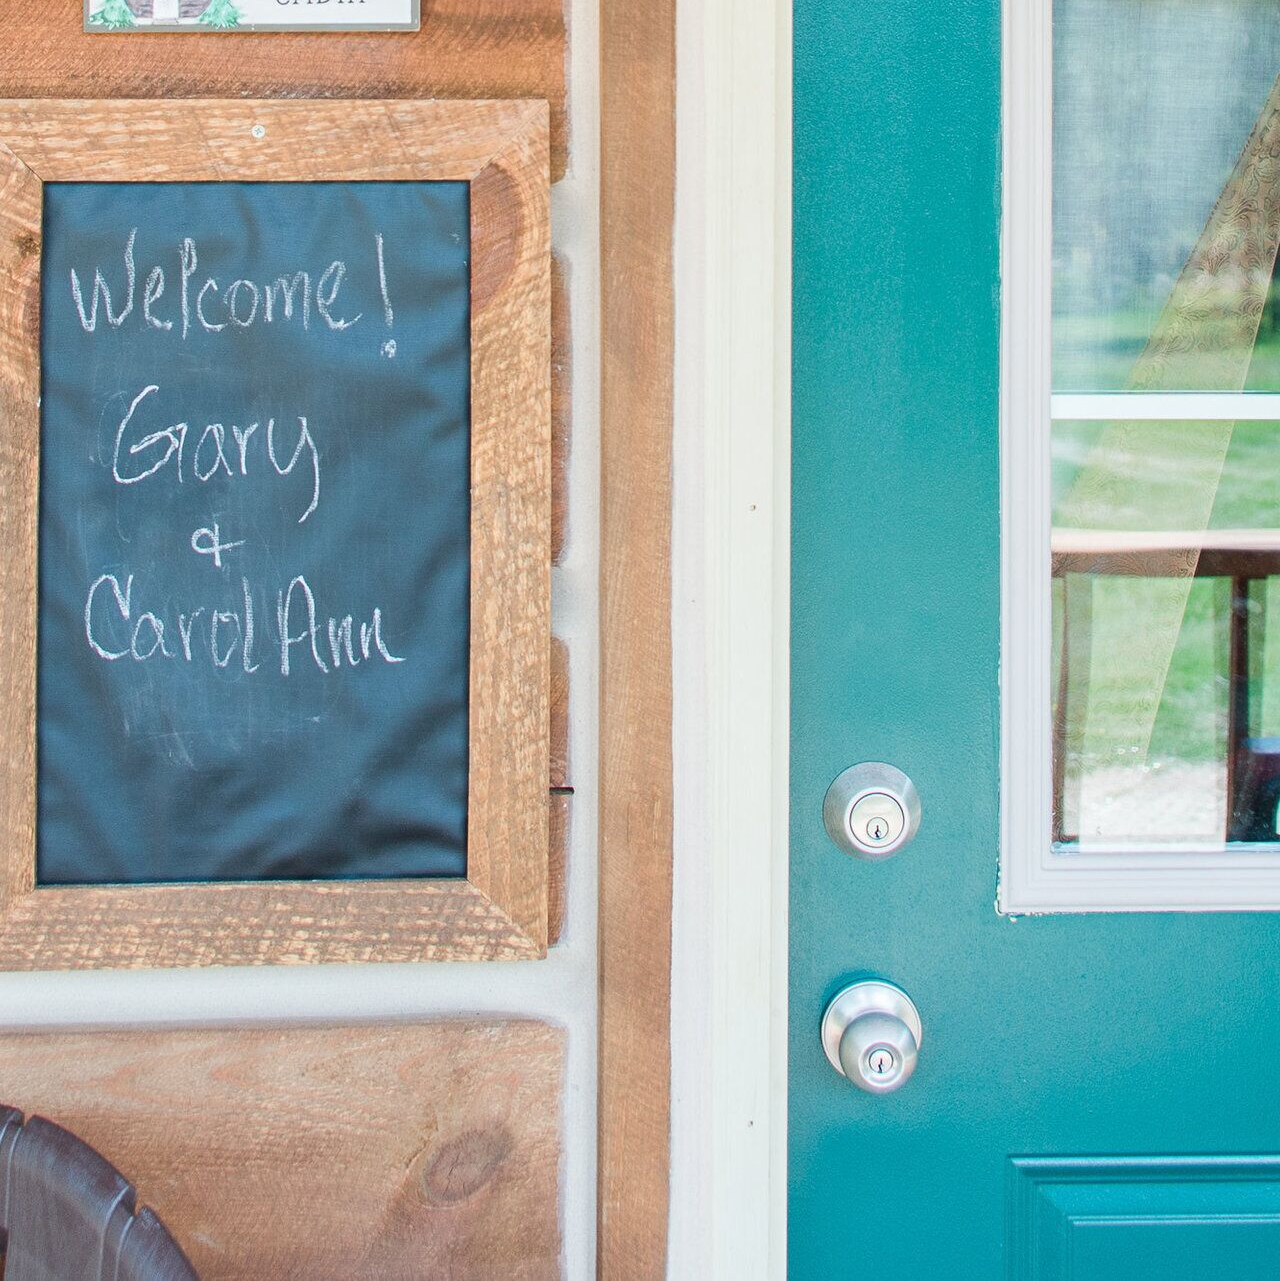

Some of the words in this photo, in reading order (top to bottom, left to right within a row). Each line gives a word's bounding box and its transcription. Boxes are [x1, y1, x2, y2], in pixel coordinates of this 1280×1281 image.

[113, 385, 321, 522] Gary
[84, 575, 260, 673] Carol
[277, 576, 406, 675] Ann
